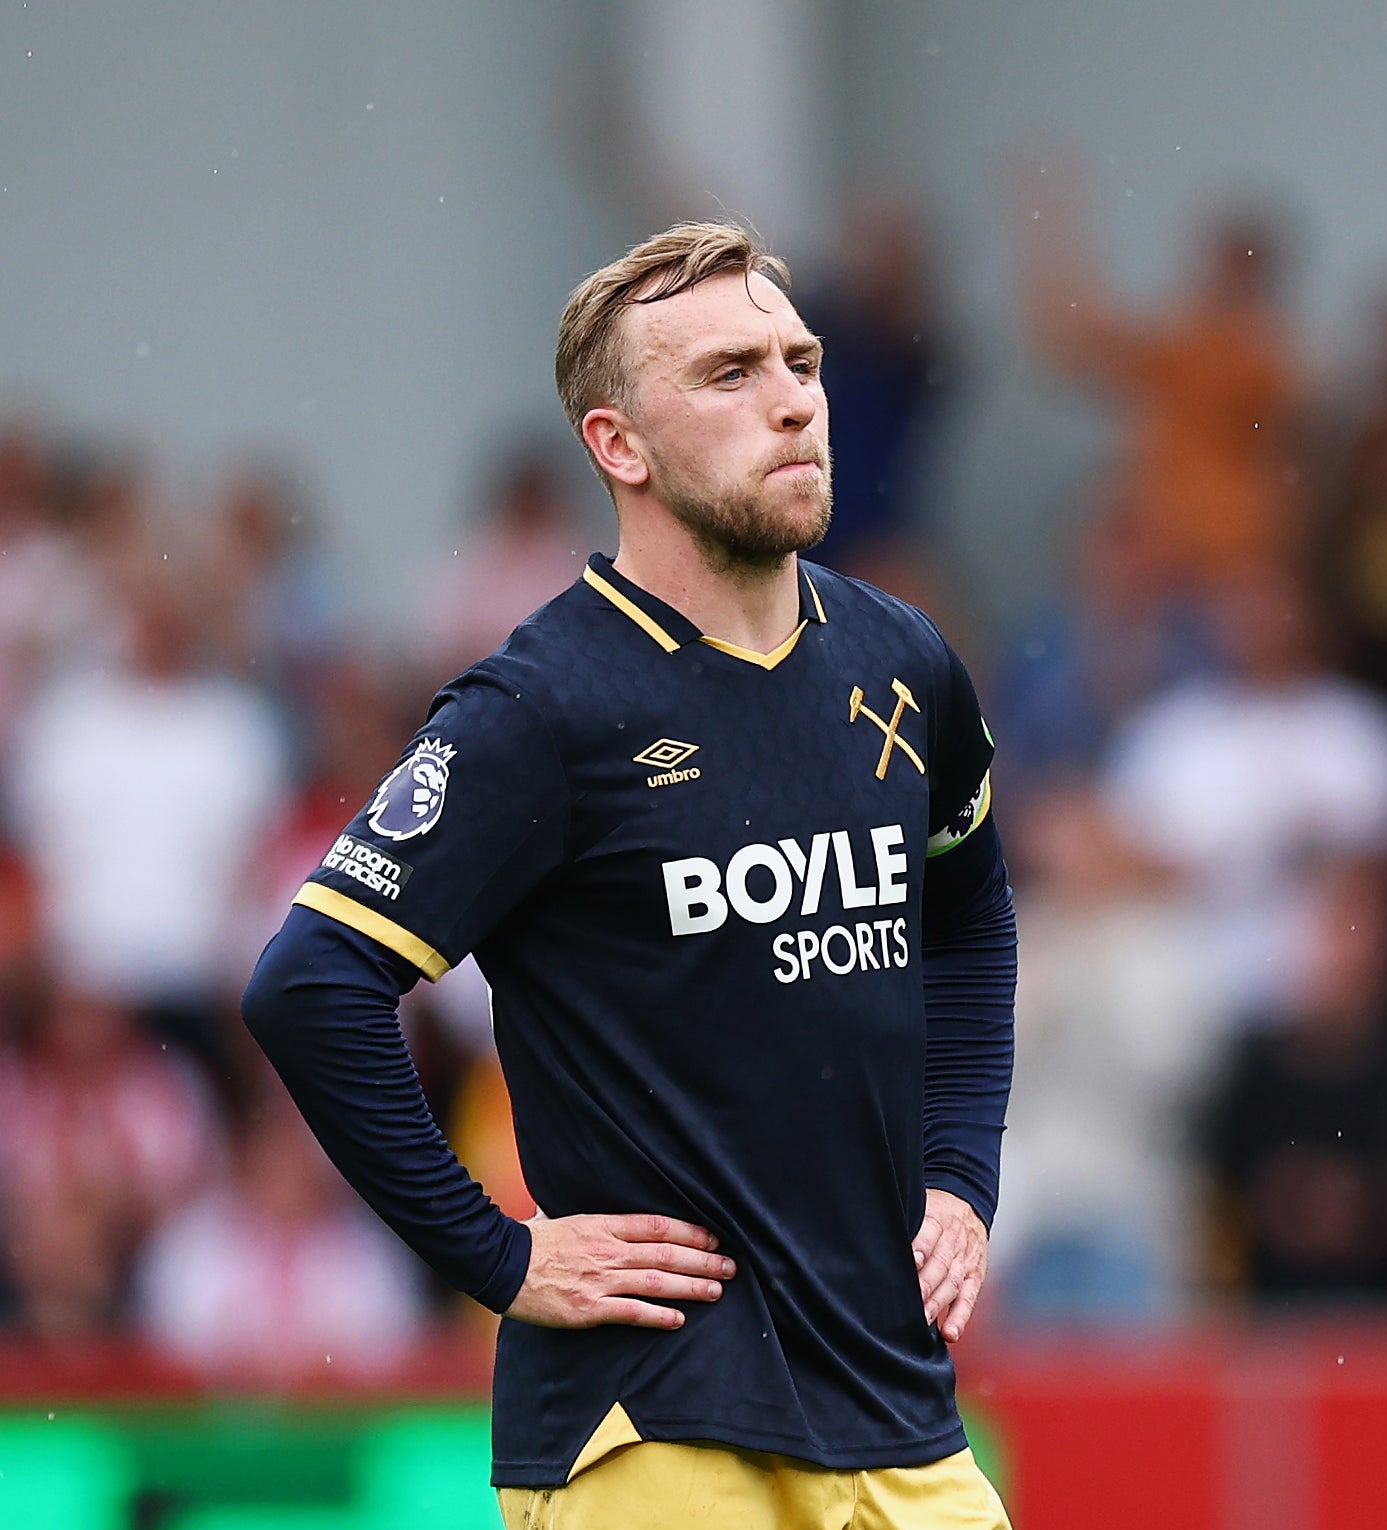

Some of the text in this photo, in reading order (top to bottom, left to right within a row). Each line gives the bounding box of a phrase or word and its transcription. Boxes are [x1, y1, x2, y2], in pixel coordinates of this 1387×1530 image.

[646, 767, 701, 788] umbro
[331, 834, 401, 881] No room
[338, 858, 401, 901] racism
[661, 824, 908, 937] BOYLE
[772, 917, 909, 984] SPORTS
